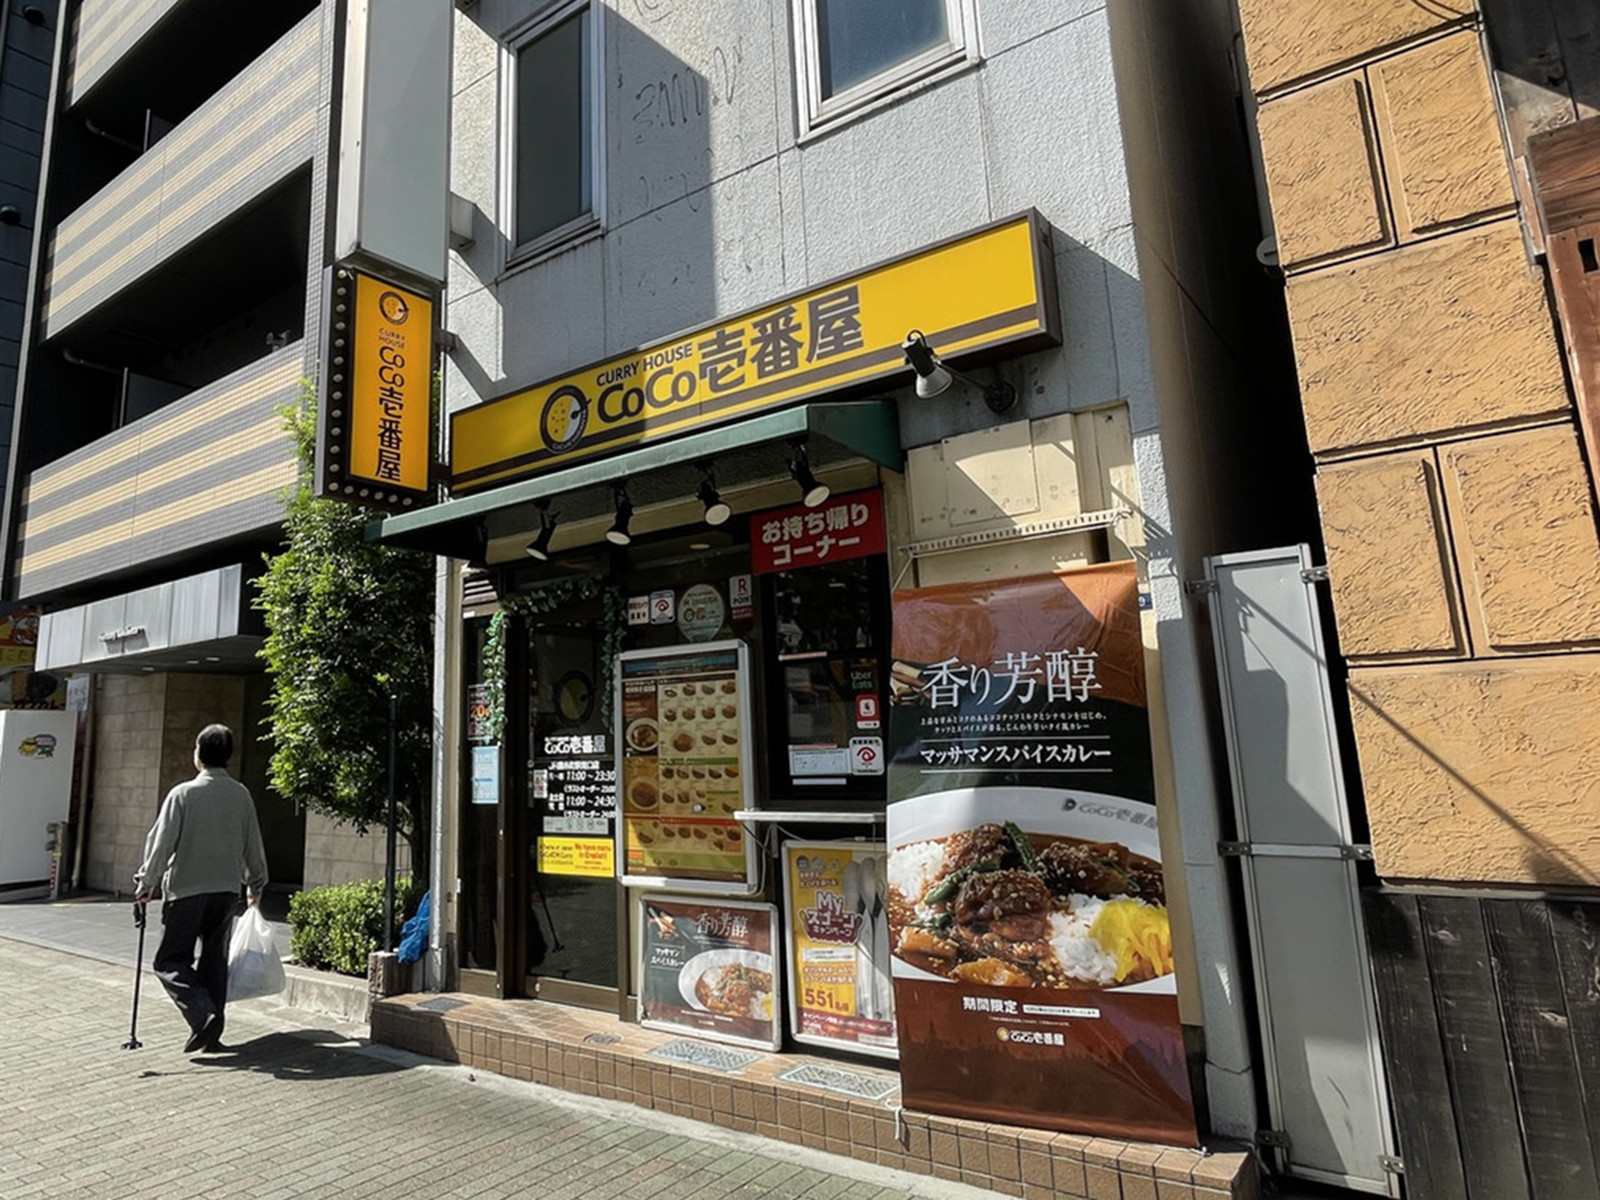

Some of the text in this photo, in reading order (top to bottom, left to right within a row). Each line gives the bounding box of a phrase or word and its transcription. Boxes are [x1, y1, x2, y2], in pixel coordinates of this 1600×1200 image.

[378, 335, 405, 349] HOUSE
[379, 327, 406, 341] CURRY
[596, 341, 693, 387] CURRY HOUSE
[597, 285, 865, 424] CoCo壱番屋
[375, 345, 405, 482] CoCo壱番屋
[761, 503, 869, 543] お持ち帰り
[772, 534, 860, 566] コーナー
[850, 671, 872, 681] Uber
[851, 680, 873, 690] Eats
[921, 647, 1102, 709] 香り芳醇
[920, 743, 1111, 766] マッサマンスパイスカレー
[566, 771, 587, 781] 11:00
[594, 771, 617, 781] 23:30
[566, 796, 586, 807] 11:00
[594, 795, 617, 807] 24:30
[817, 891, 843, 915] My
[696, 911, 749, 937] 香り芳醇
[962, 996, 1019, 1015] 期間限定
